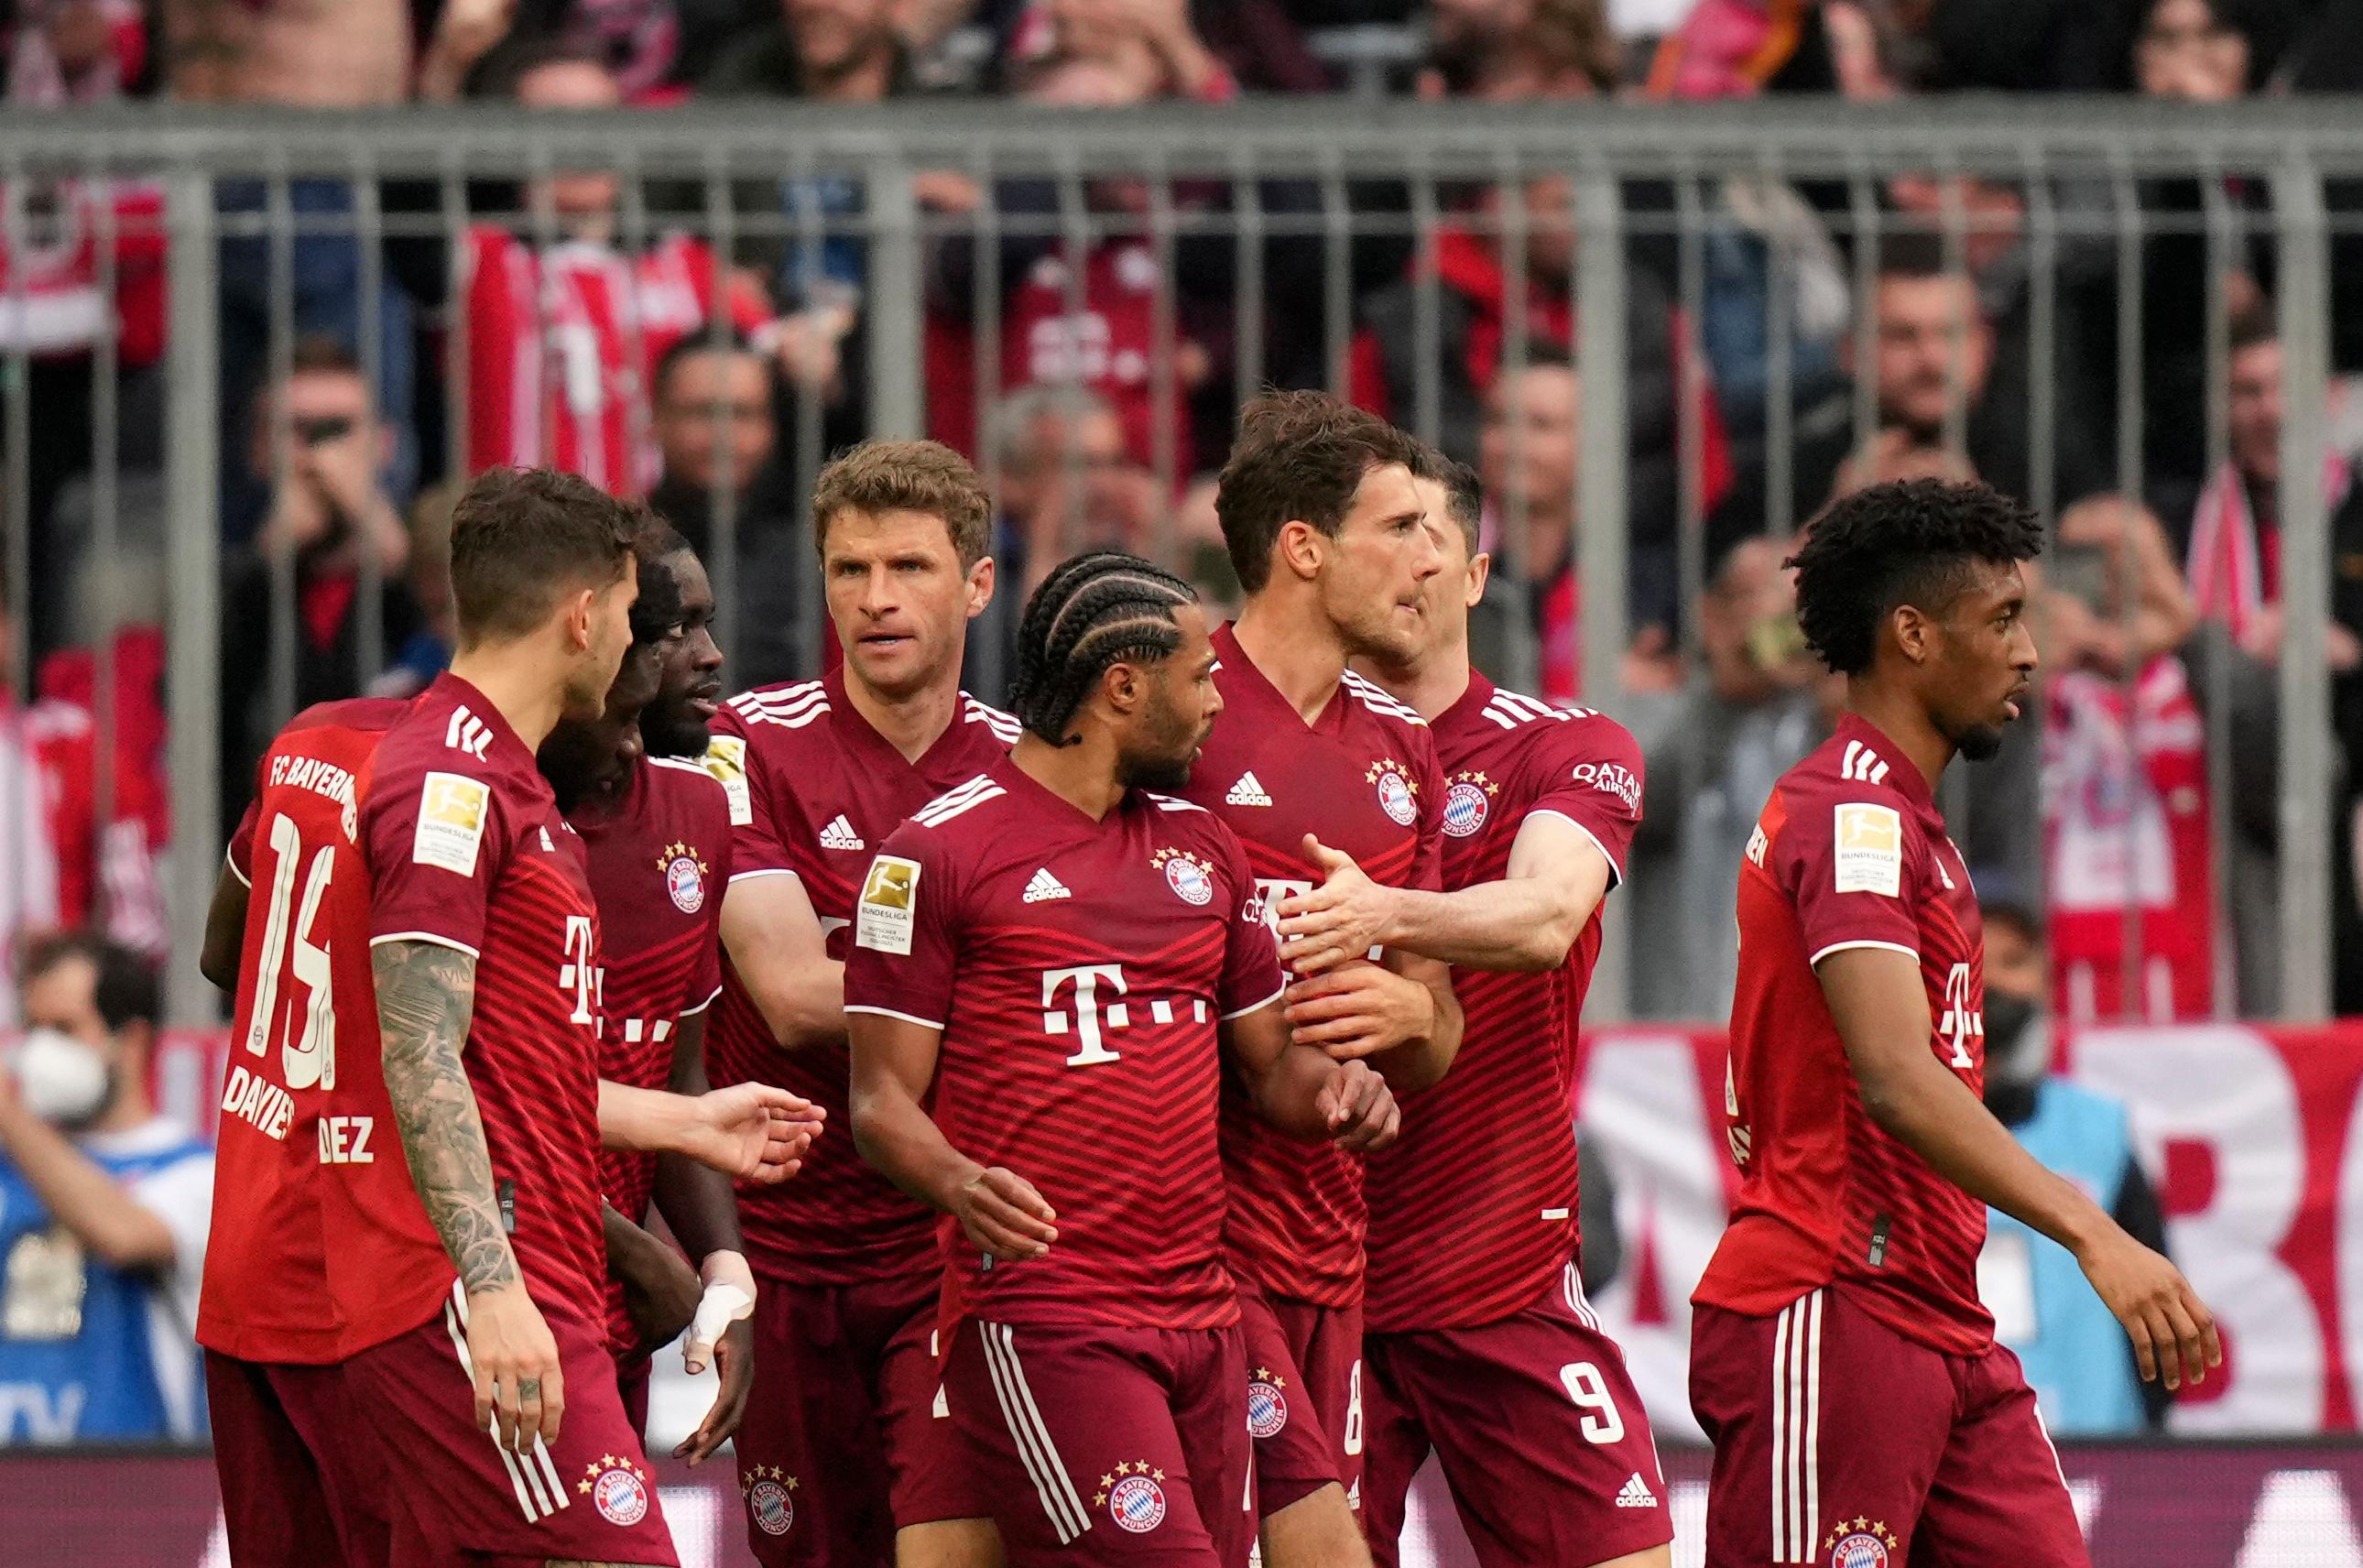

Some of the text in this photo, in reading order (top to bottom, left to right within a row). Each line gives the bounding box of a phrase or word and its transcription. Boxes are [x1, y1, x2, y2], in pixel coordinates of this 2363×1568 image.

[269, 756, 291, 787] FC
[1225, 793, 1273, 807] adidas
[1841, 850, 1895, 864] BUNDESLIGA
[1022, 887, 1072, 904] adidas
[861, 906, 908, 921] BUNDESLIGA
[1042, 964, 1128, 1066] T
[1559, 1361, 1625, 1444] 9
[1615, 1496, 1658, 1508] adidas
[1847, 1538, 1884, 1560] BAYERN
